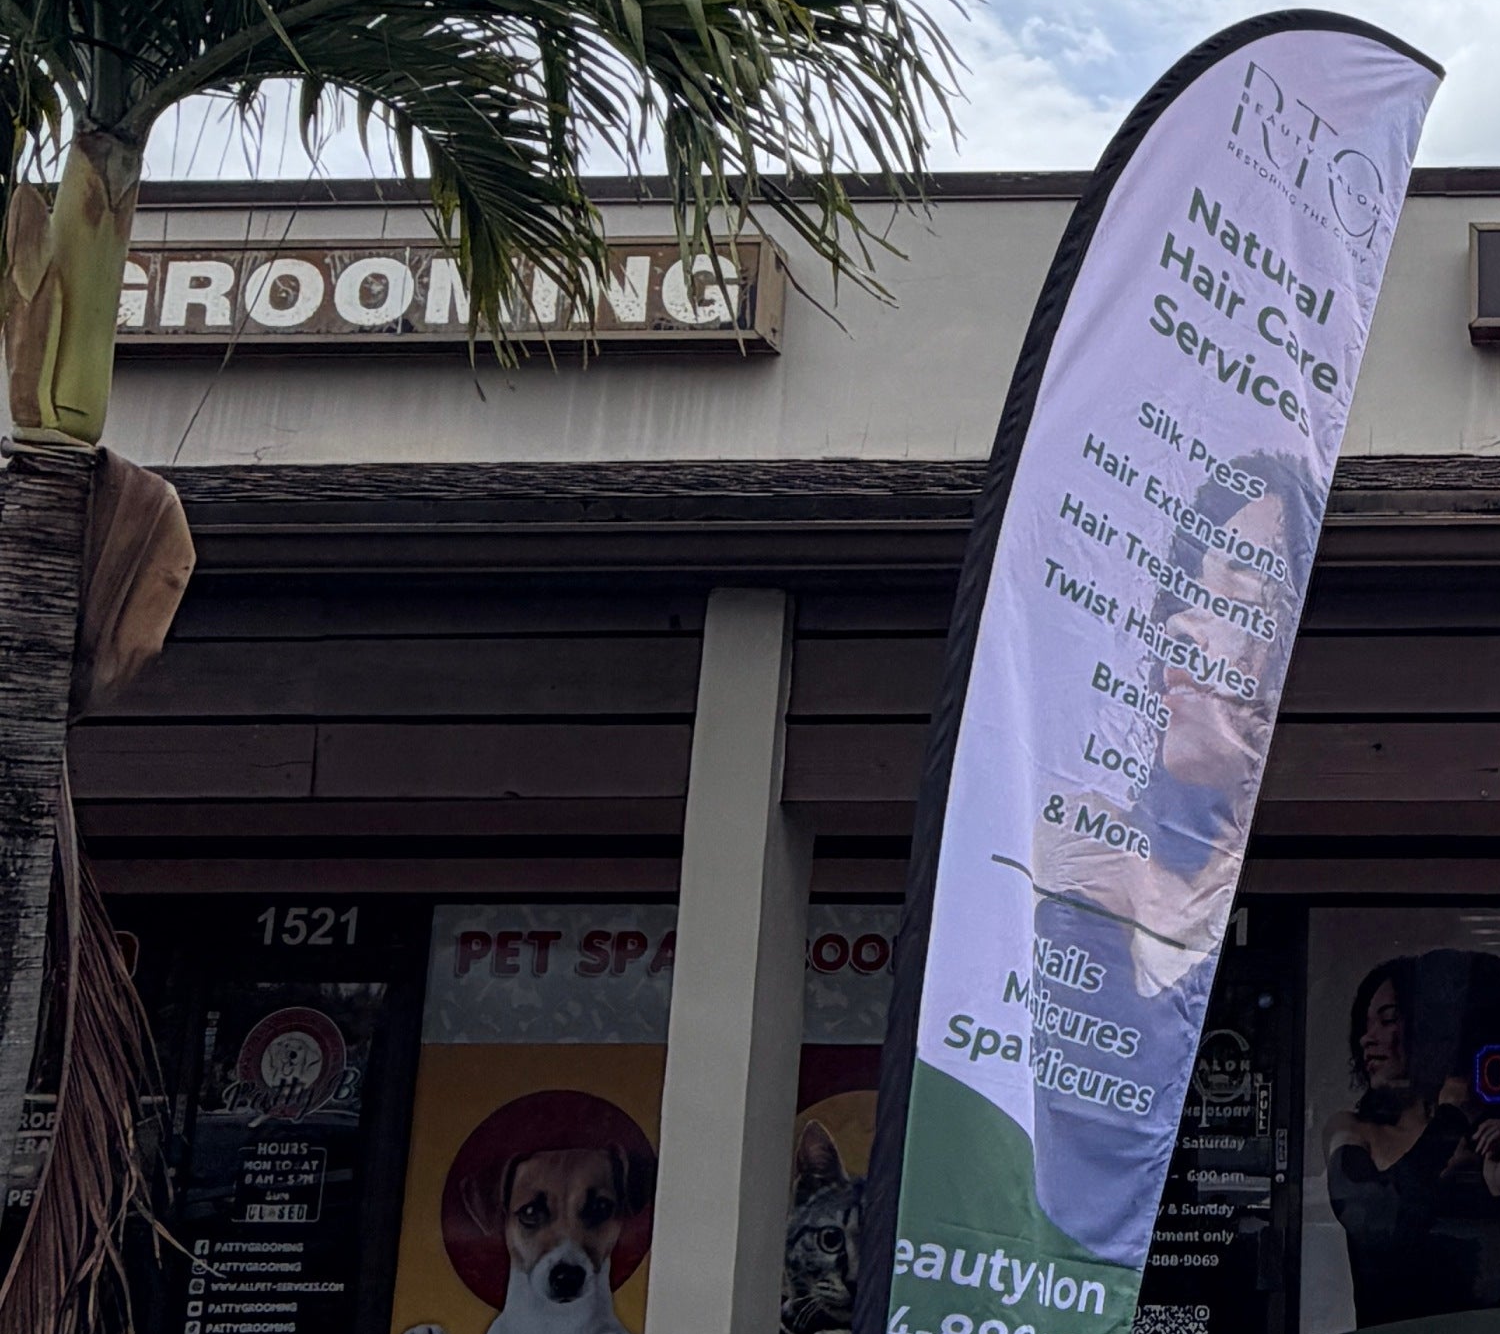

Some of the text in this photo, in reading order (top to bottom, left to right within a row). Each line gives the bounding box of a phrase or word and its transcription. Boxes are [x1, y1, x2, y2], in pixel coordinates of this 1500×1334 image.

[1231, 61, 1384, 250] RTG
[1241, 92, 1381, 216] BEAUTY SALON
[1226, 140, 1297, 206] RESTORING
[1302, 203, 1328, 229] THE
[1188, 186, 1335, 326] Natural
[1159, 231, 1339, 395] Hair Care
[1149, 293, 1310, 437] Services
[1138, 401, 1265, 500] Silk Press
[1081, 432, 1287, 580] Hair Extensions
[1059, 492, 1276, 641] Hair Treatments
[1045, 558, 1257, 700] Twist Hairstyles
[1091, 661, 1171, 729] Braids
[1083, 733, 1149, 787] Locs
[1043, 794, 1150, 859] & More
[257, 906, 359, 946] 1521
[456, 930, 562, 976] PET
[1034, 936, 1105, 991] Nails
[1002, 970, 1139, 1055] Micures
[943, 1014, 1023, 1062] Spa
[1029, 1036, 1153, 1113] dicures
[1258, 1089, 1269, 1131] PULL
[243, 1160, 272, 1171] MON
[294, 1160, 319, 1171] AT
[257, 1142, 309, 1156] HOURS
[1182, 1136, 1246, 1152] Saturday
[255, 1173, 275, 1185] AM
[1186, 1169, 1218, 1182] 6:00
[1221, 1171, 1245, 1184] pm
[1167, 1203, 1178, 1216] &
[1181, 1203, 1235, 1218] Sunday
[1202, 1229, 1235, 1246] only
[212, 1261, 302, 1273] PATTYGROOMING
[214, 1242, 304, 1253] PATTYGROOMING
[205, 1322, 297, 1334] PATTYGROOMING
[207, 1302, 298, 1314] PATTYGROOMING
